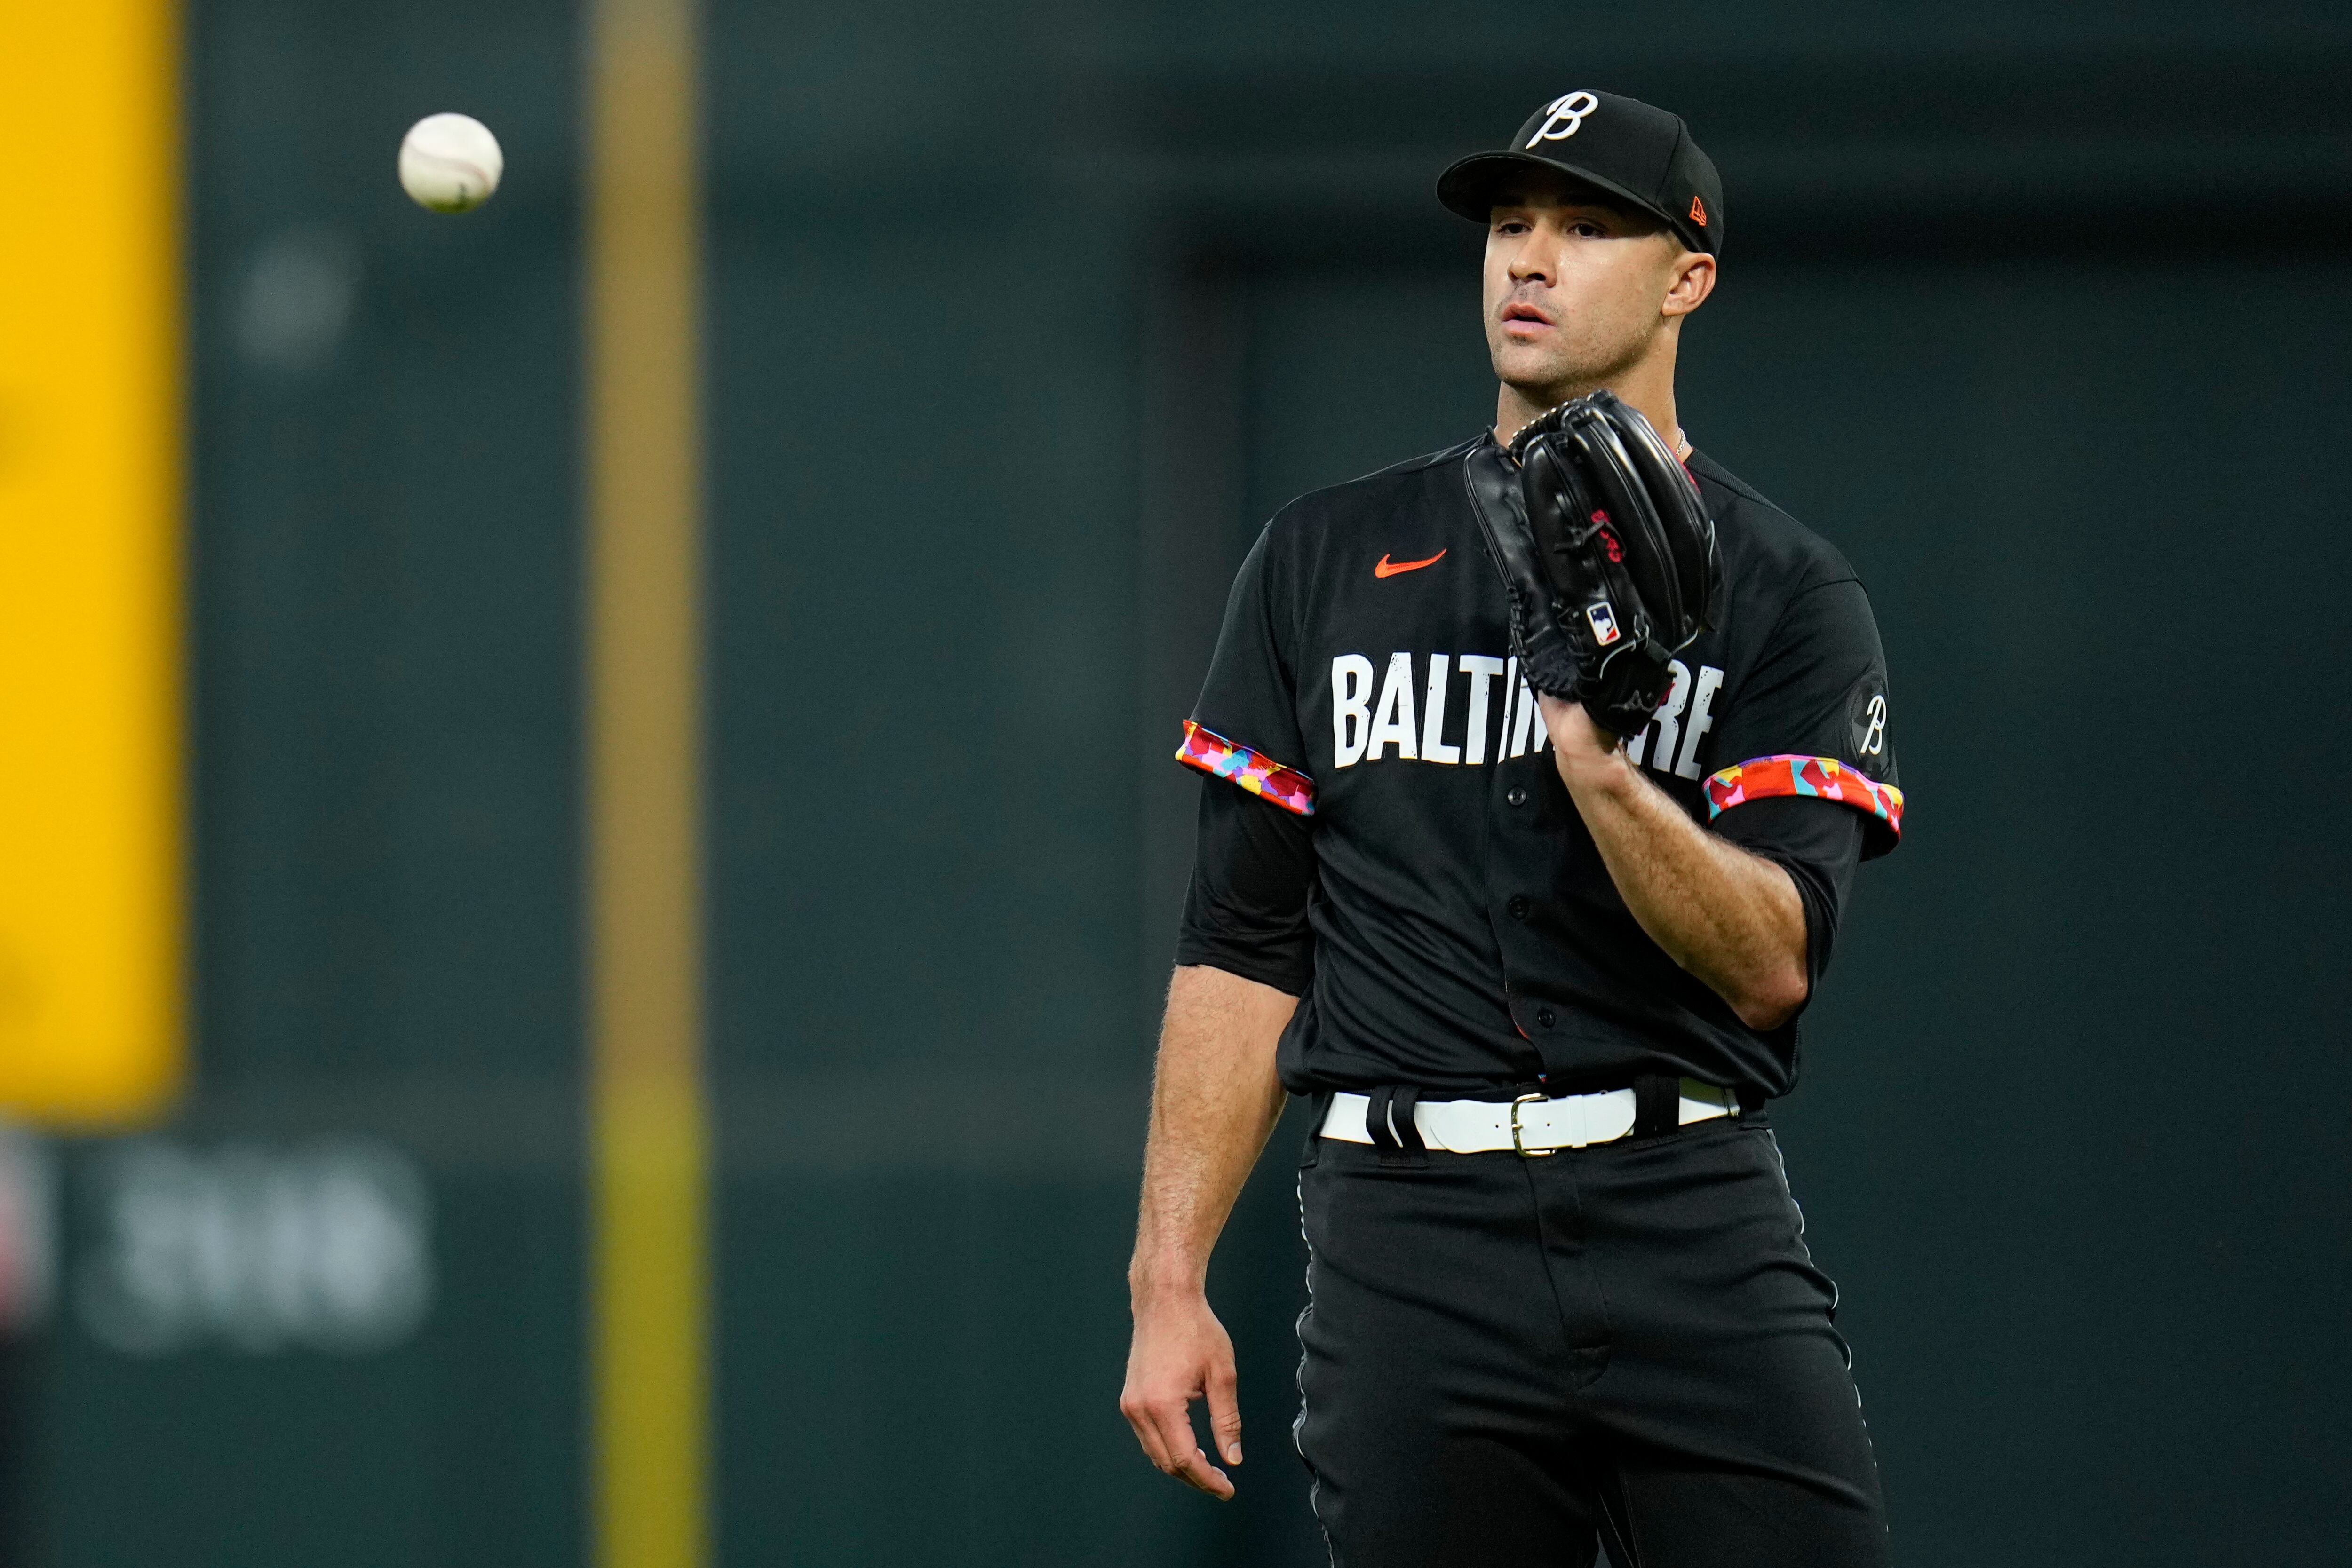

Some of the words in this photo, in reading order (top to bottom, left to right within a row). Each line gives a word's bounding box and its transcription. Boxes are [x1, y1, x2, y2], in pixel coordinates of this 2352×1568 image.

[1526, 91, 1598, 149] B
[1332, 652, 1724, 781] BALTIRE
[1860, 695, 1887, 755] B
